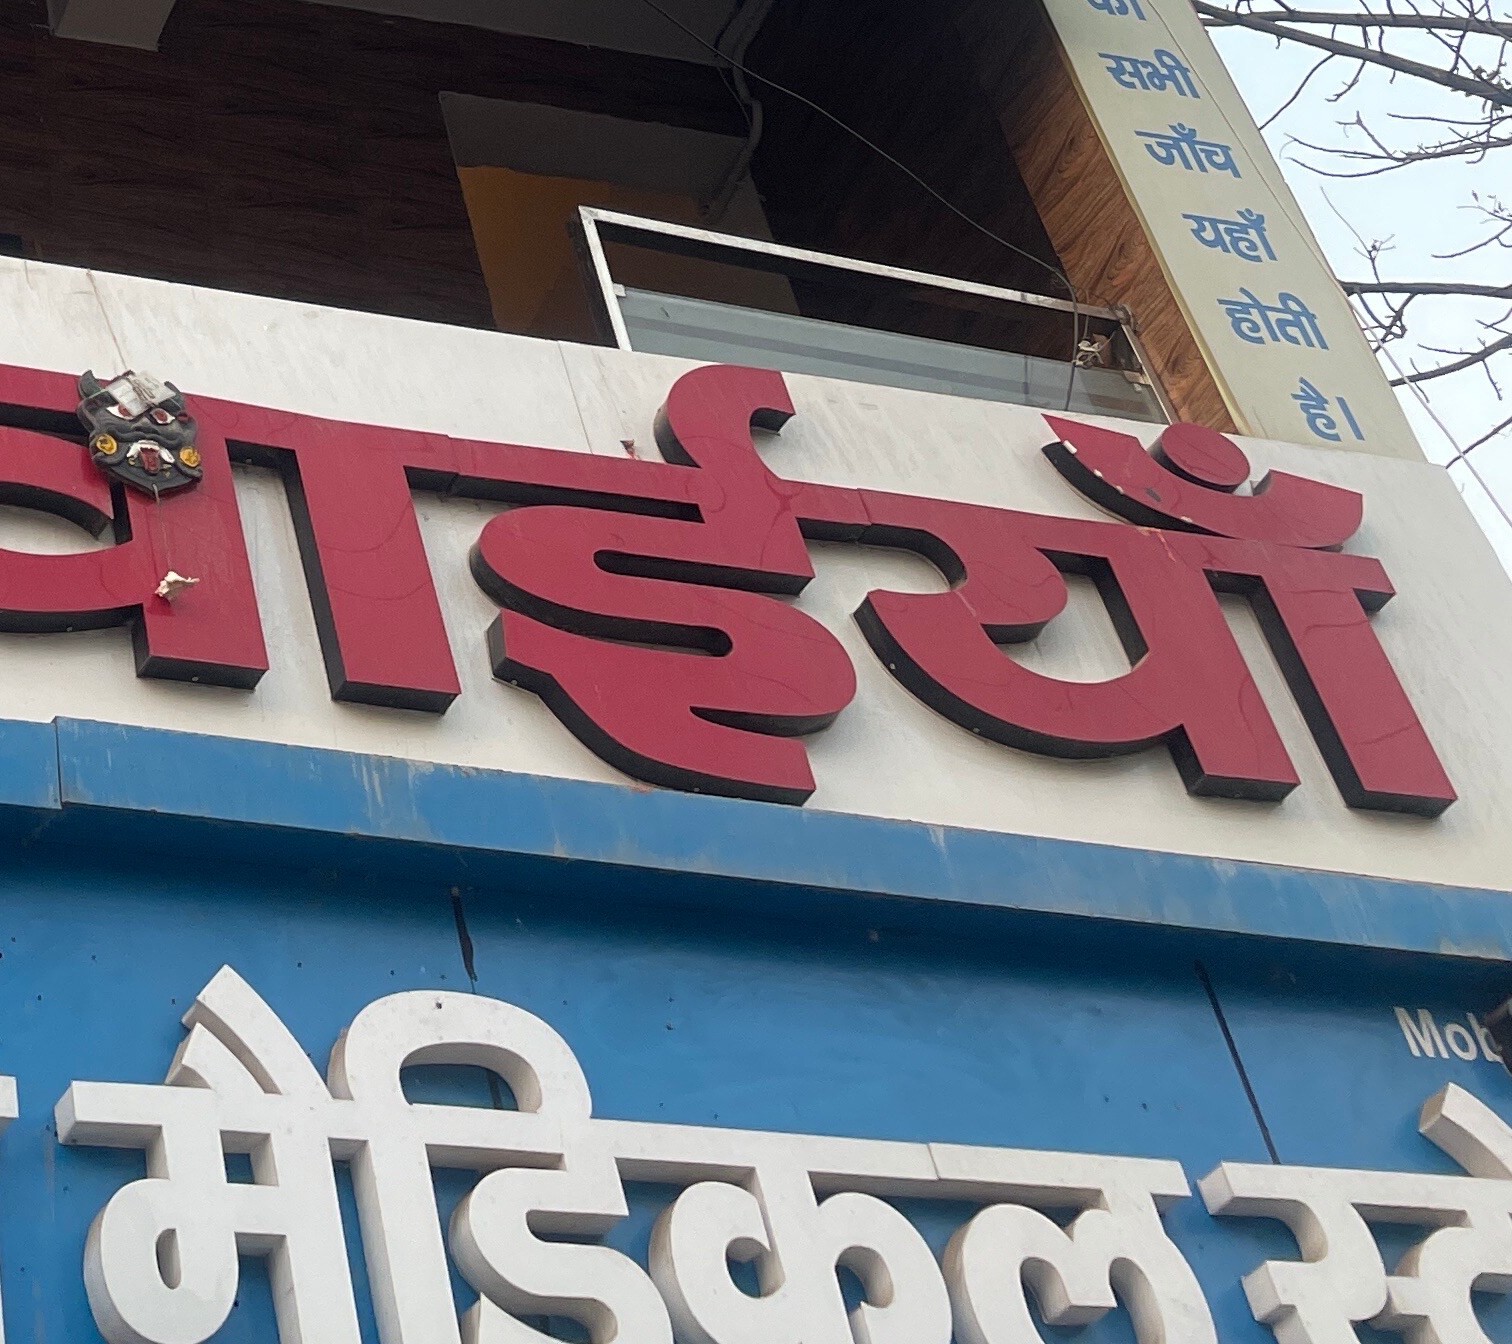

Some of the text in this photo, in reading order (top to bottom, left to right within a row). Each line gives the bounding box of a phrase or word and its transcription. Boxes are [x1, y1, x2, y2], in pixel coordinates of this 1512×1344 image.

[1098, 49, 1200, 99] सभी
[1134, 122, 1242, 179] जाँच
[1182, 208, 1278, 262] यहाँ
[1217, 287, 1329, 350] होती
